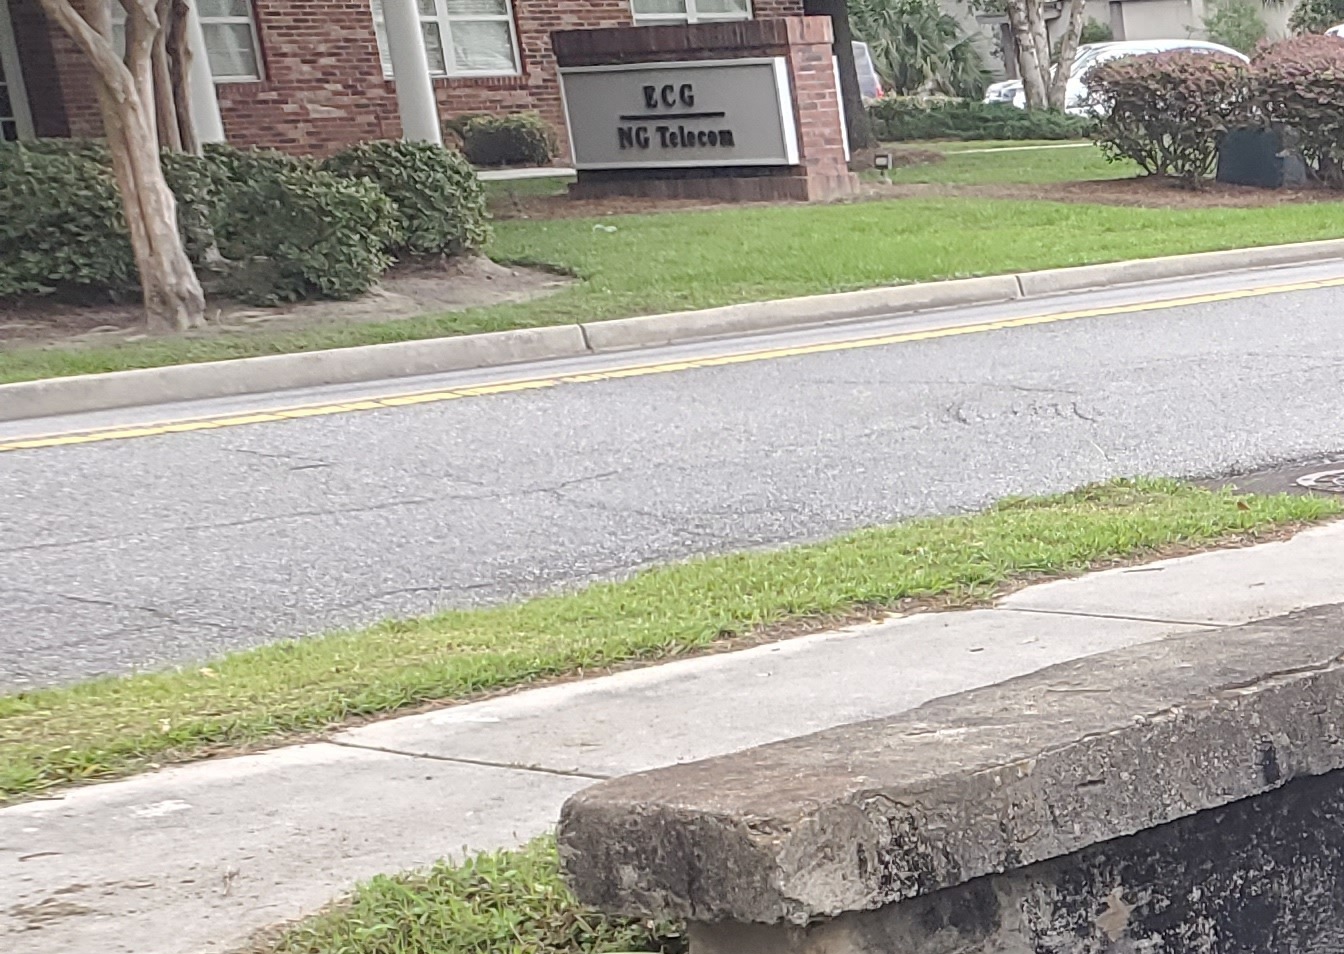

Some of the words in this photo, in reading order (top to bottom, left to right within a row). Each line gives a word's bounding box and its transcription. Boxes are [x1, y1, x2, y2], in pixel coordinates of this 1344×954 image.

[643, 84, 695, 109] ECG
[617, 126, 650, 150] NG
[656, 125, 735, 149] Telecom
